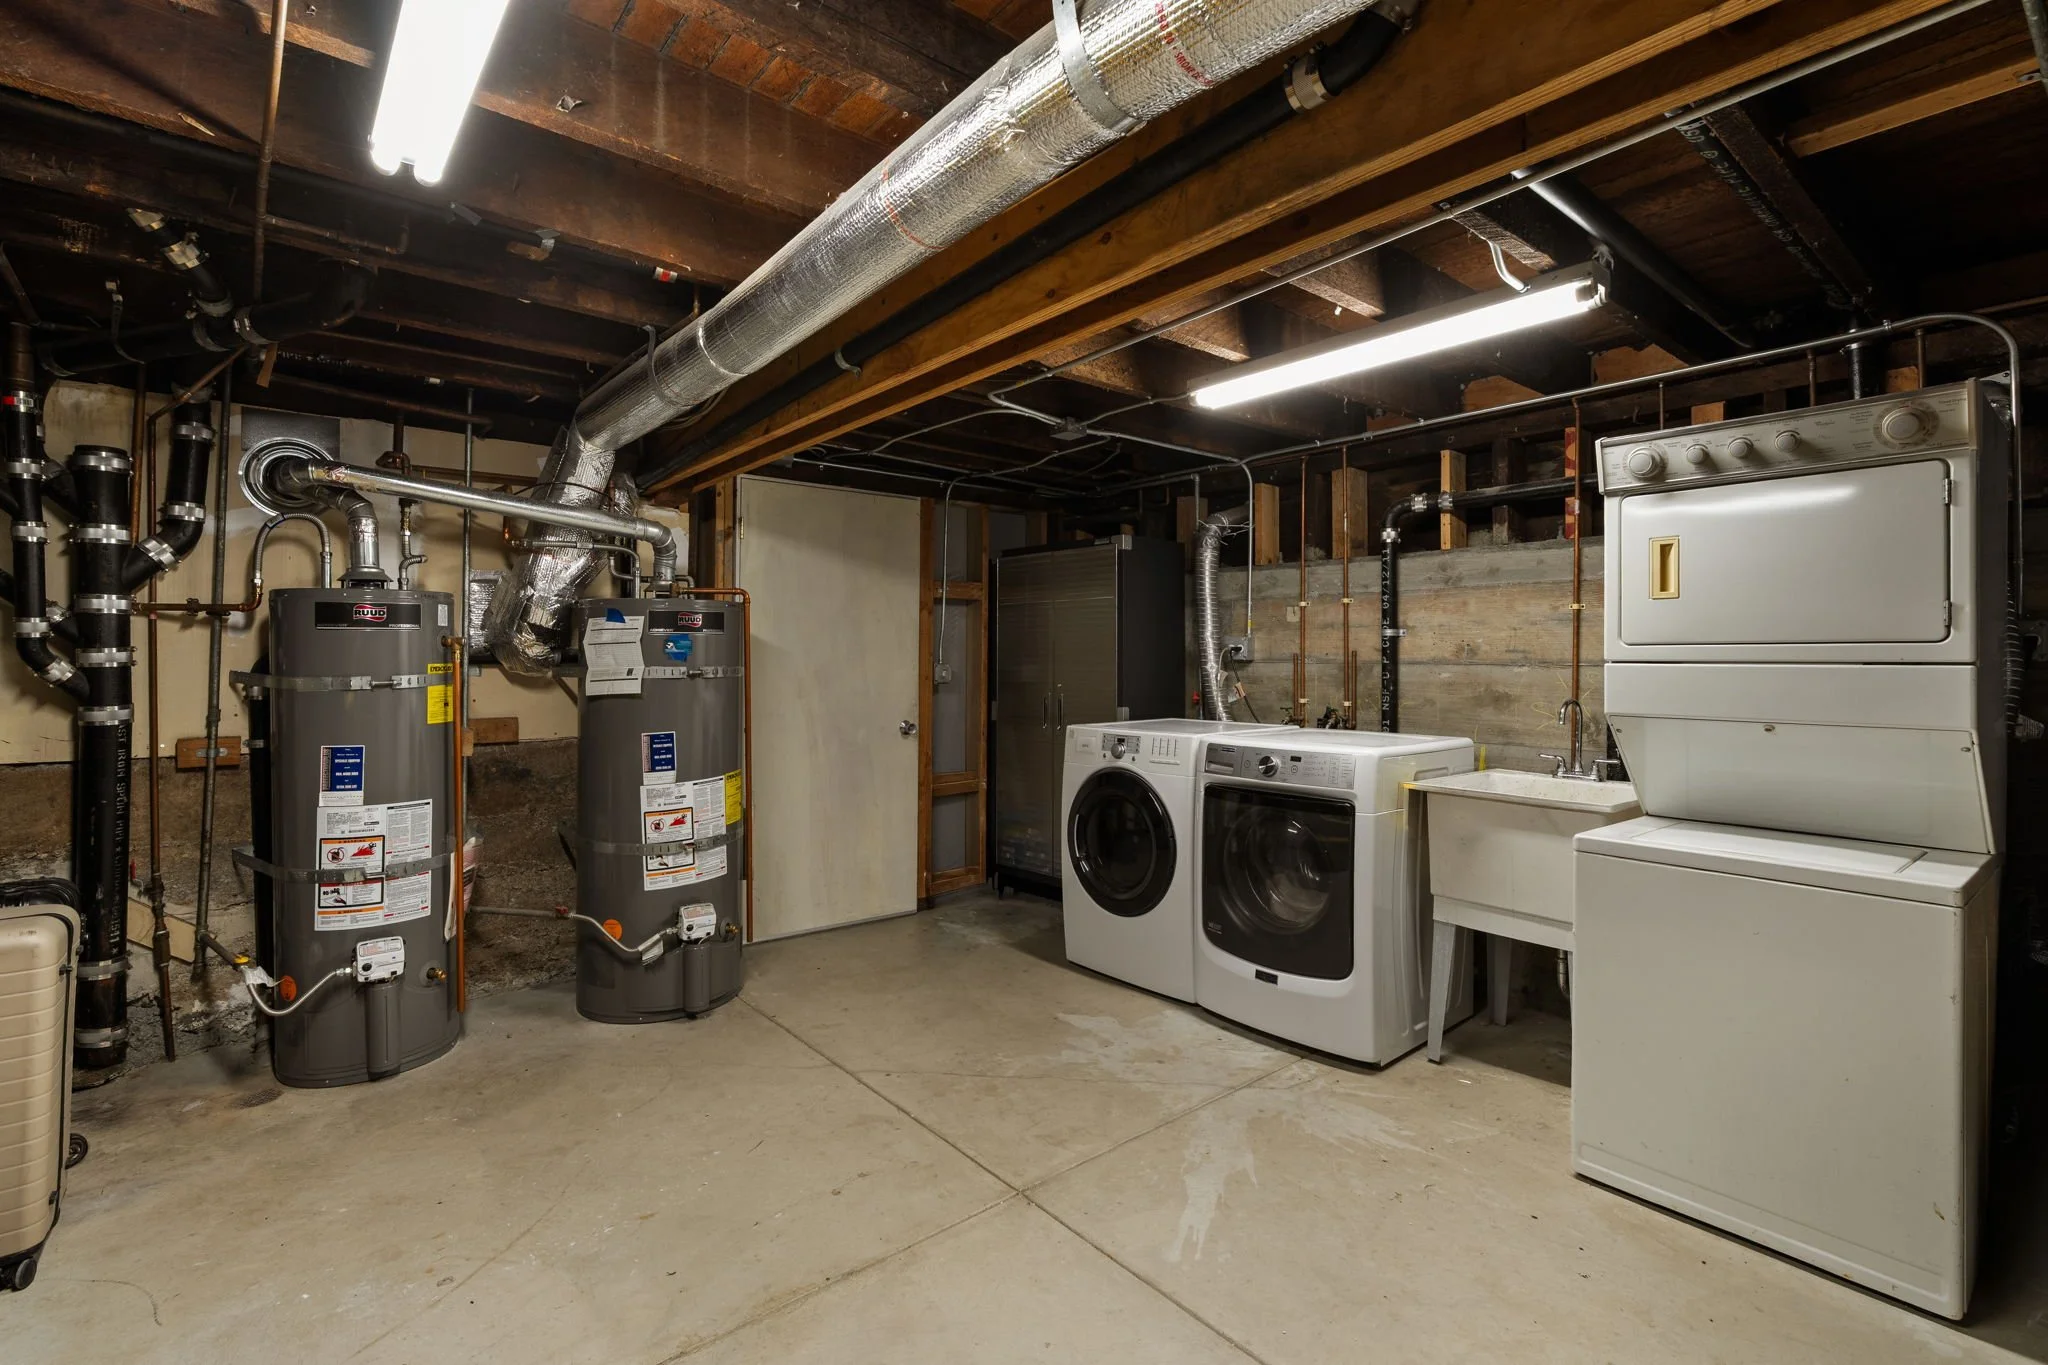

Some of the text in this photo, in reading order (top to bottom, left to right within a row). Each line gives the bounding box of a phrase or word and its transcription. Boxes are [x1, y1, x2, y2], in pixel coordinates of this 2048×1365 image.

[1174, 51, 1196, 74] SMOKE
[1381, 547, 1390, 609] 04/12/11
[353, 608, 386, 618] RUUD
[678, 616, 702, 624] RUUD
[116, 748, 127, 778] IRON
